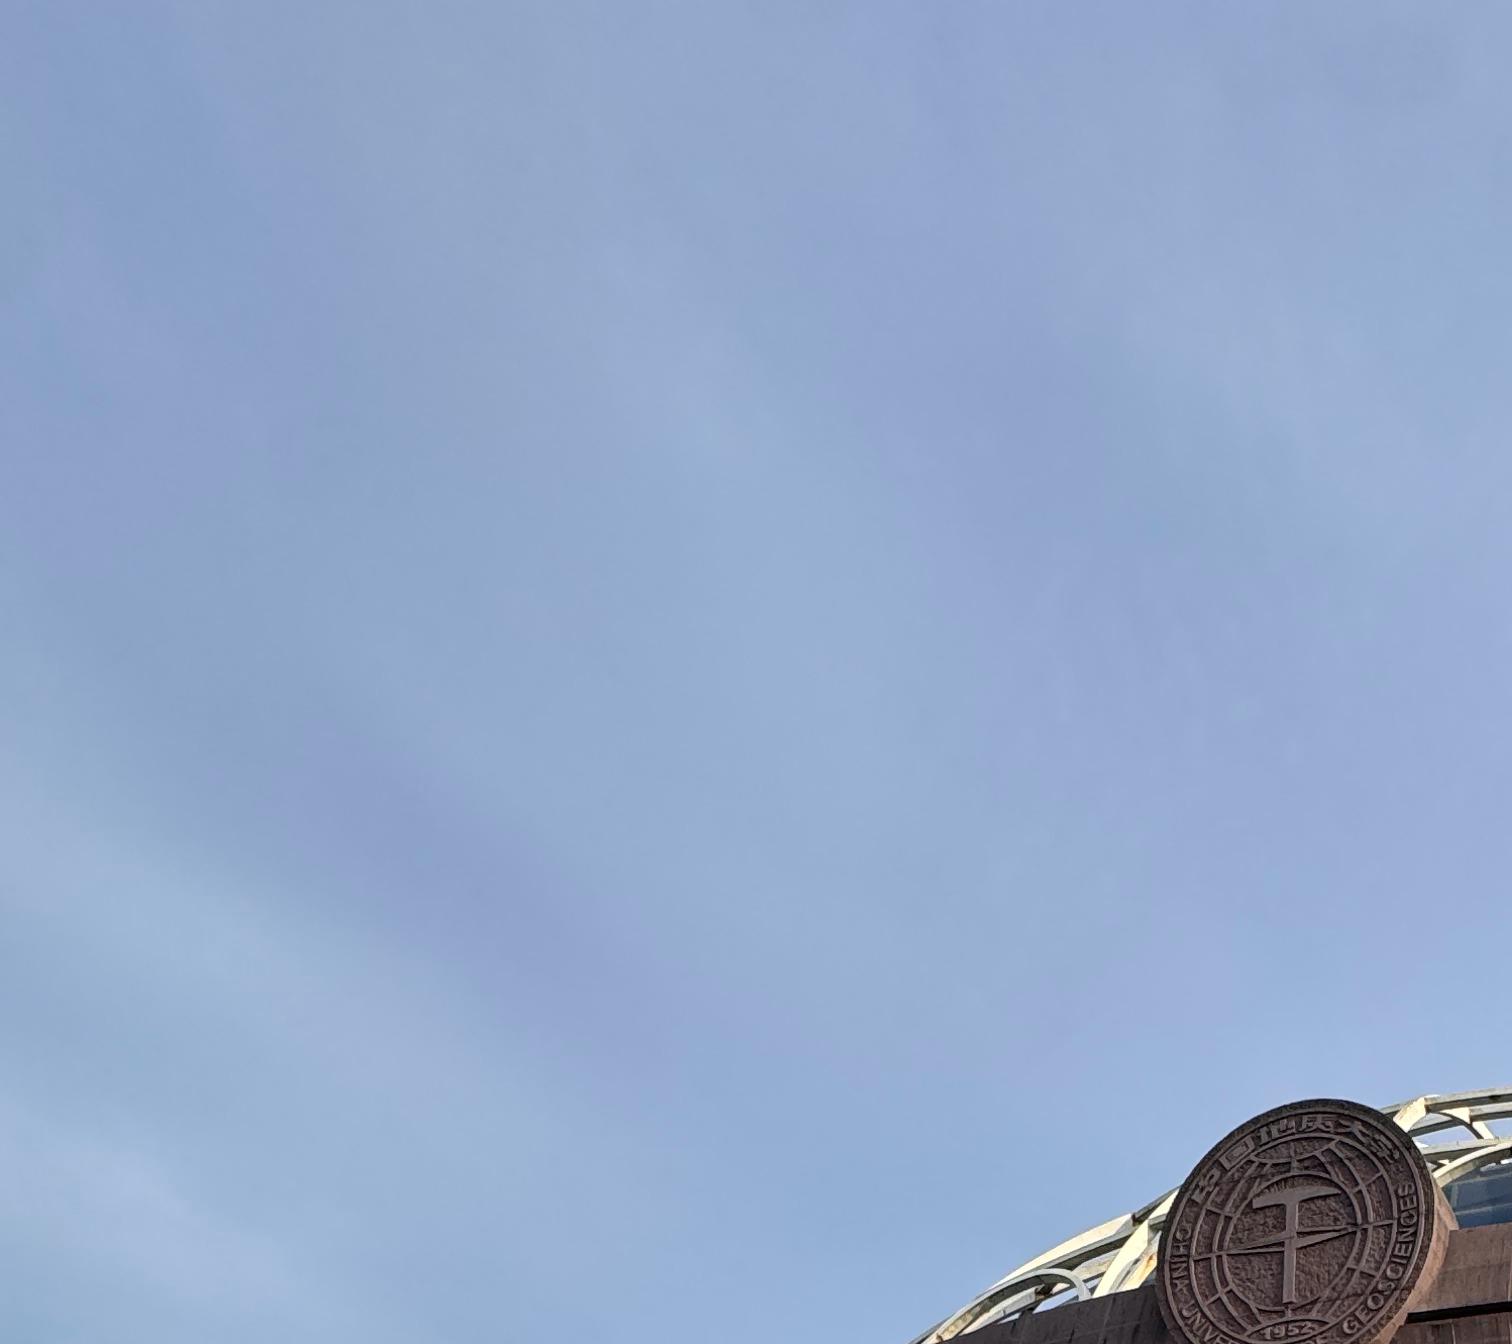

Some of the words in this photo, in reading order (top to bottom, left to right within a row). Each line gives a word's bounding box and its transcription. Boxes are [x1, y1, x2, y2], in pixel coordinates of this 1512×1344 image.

[1170, 1225, 1192, 1290] CHINA
[1342, 1182, 1418, 1336] GEOSCIENCES
[1262, 1322, 1317, 1340] 1952
